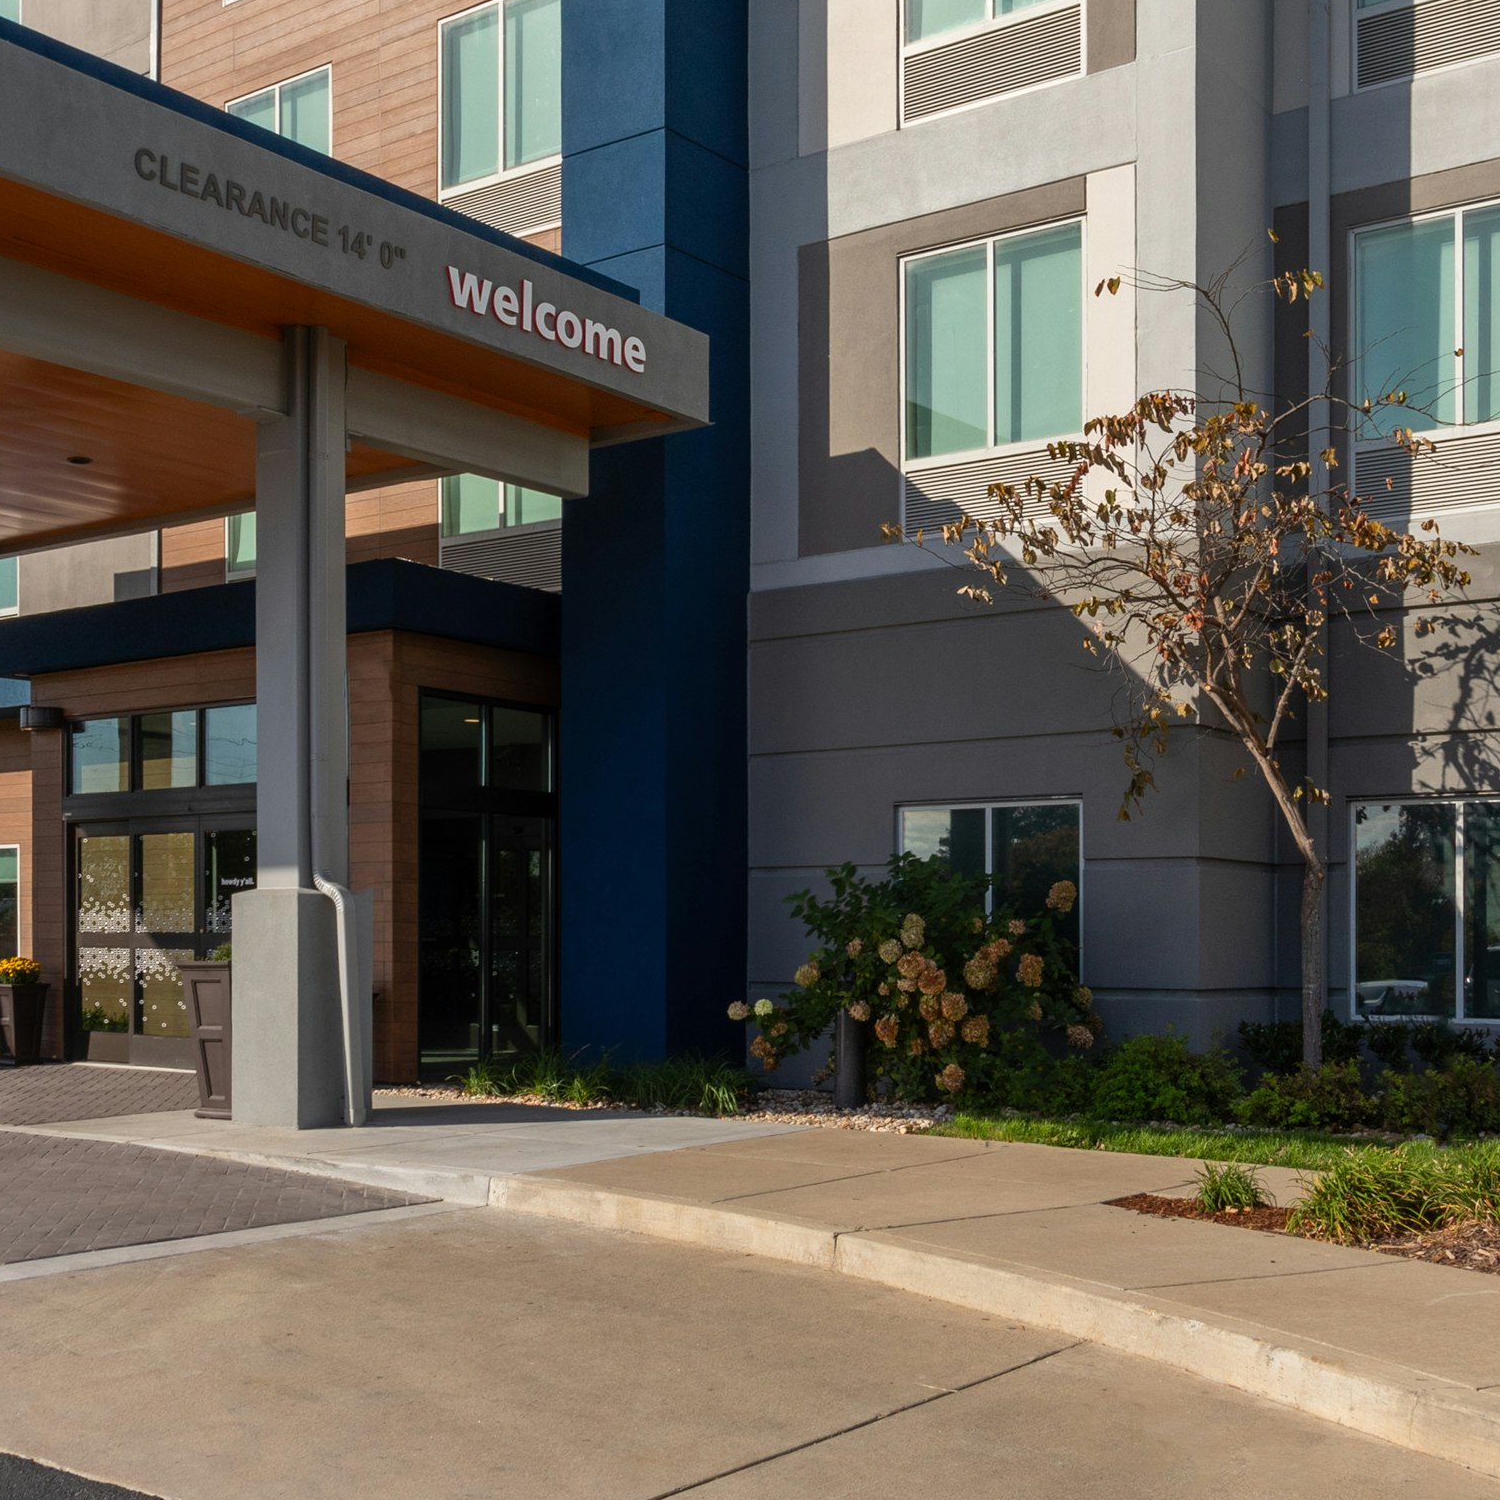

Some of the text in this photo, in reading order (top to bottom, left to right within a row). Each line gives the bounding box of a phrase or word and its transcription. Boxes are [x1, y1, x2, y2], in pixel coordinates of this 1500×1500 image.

[134, 148, 329, 247] CLEARANCE
[338, 225, 373, 260] 14'
[446, 265, 647, 373] welcome
[221, 877, 240, 887] howdy
